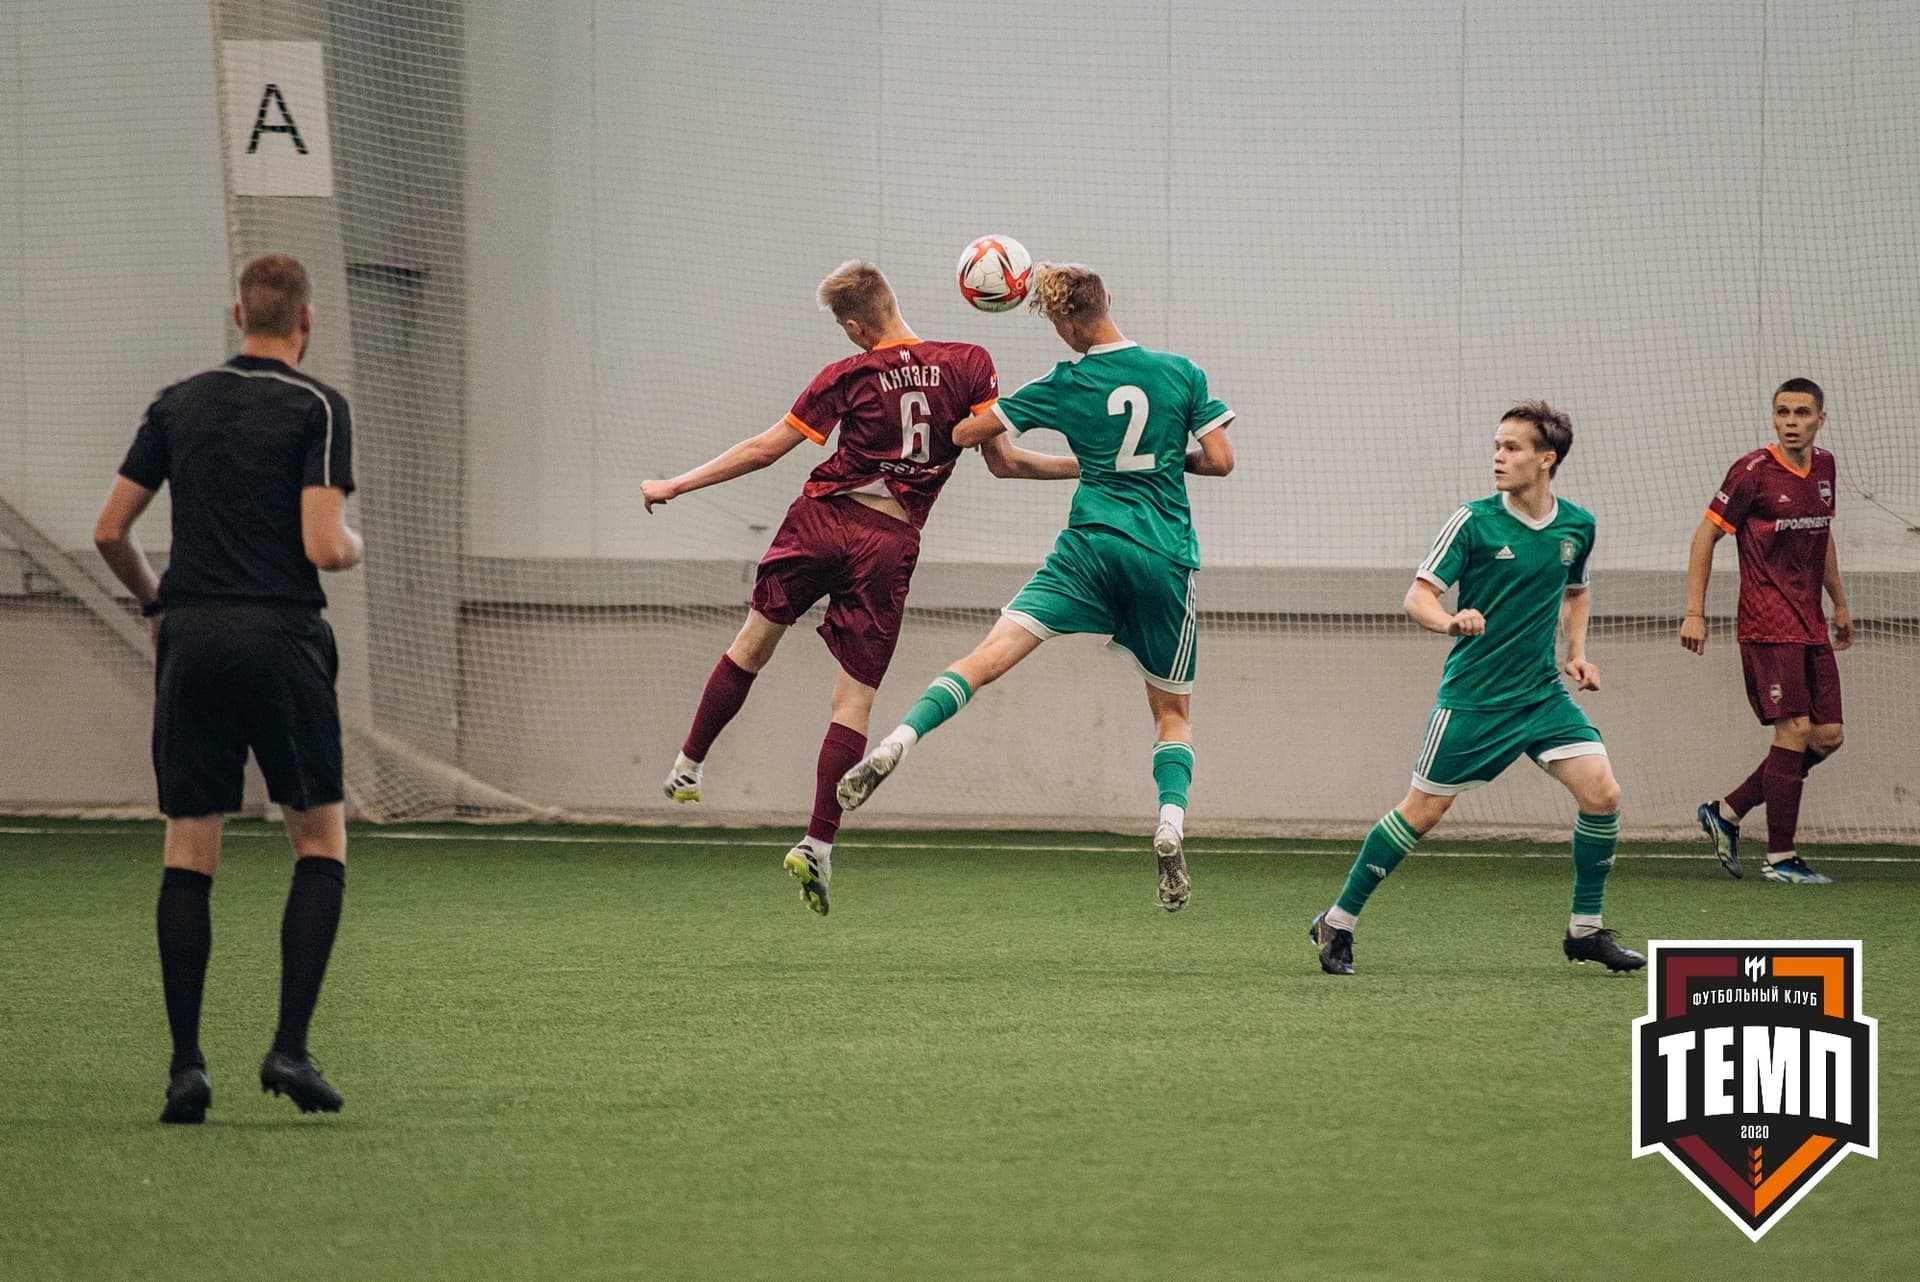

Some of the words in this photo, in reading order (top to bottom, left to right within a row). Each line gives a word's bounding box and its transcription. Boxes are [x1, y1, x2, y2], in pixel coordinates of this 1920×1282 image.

[878, 365, 940, 393] КНЯЗЕВ
[900, 391, 931, 464] 6
[1107, 385, 1156, 472] 2
